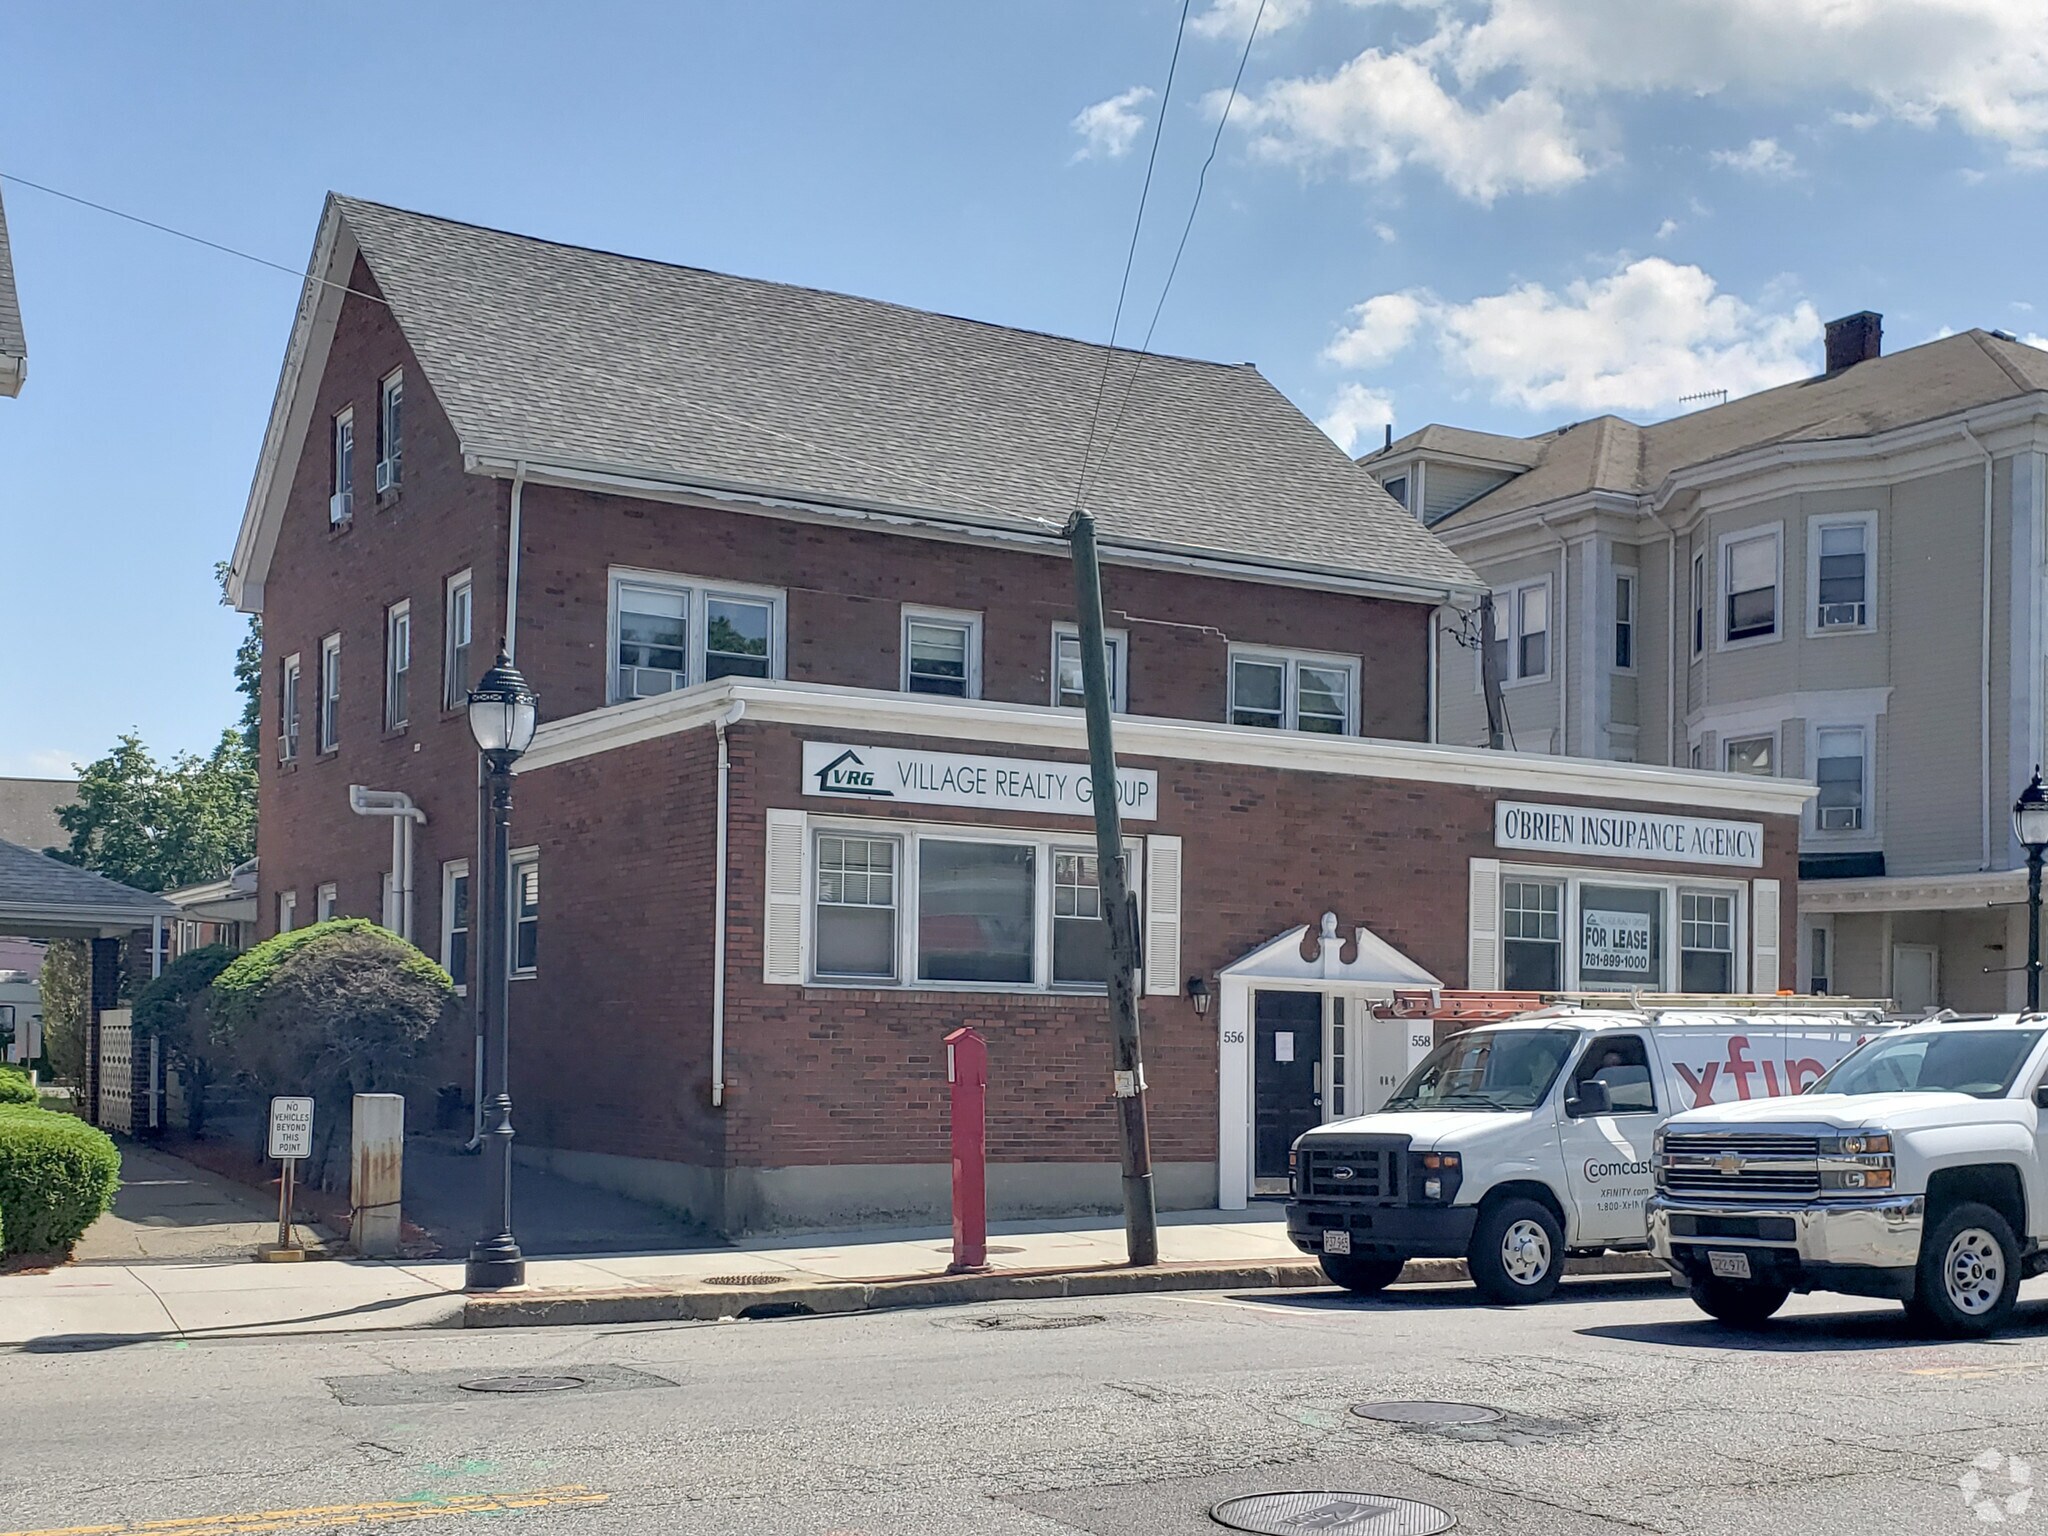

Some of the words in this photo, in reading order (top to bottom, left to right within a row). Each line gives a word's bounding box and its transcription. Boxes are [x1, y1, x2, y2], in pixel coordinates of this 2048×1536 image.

[834, 769, 875, 786] VRG
[897, 761, 988, 794] VILLAGE
[995, 769, 1068, 801] REALTY
[1075, 776, 1149, 807] GUP
[1505, 808, 1575, 844] O'BRIEN
[1581, 816, 1685, 853] INSURANCE
[1690, 826, 1758, 859] AGENCY
[1585, 926, 1607, 948] FOR
[1612, 928, 1648, 950] LEASE
[1223, 1031, 1245, 1044] 556
[1411, 1035, 1431, 1047] 558
[286, 1103, 298, 1111] NO
[275, 1113, 310, 1122] VEHICLES
[276, 1123, 307, 1132] BEYOND
[282, 1133, 299, 1142] THIS
[279, 1143, 301, 1152] POINT
